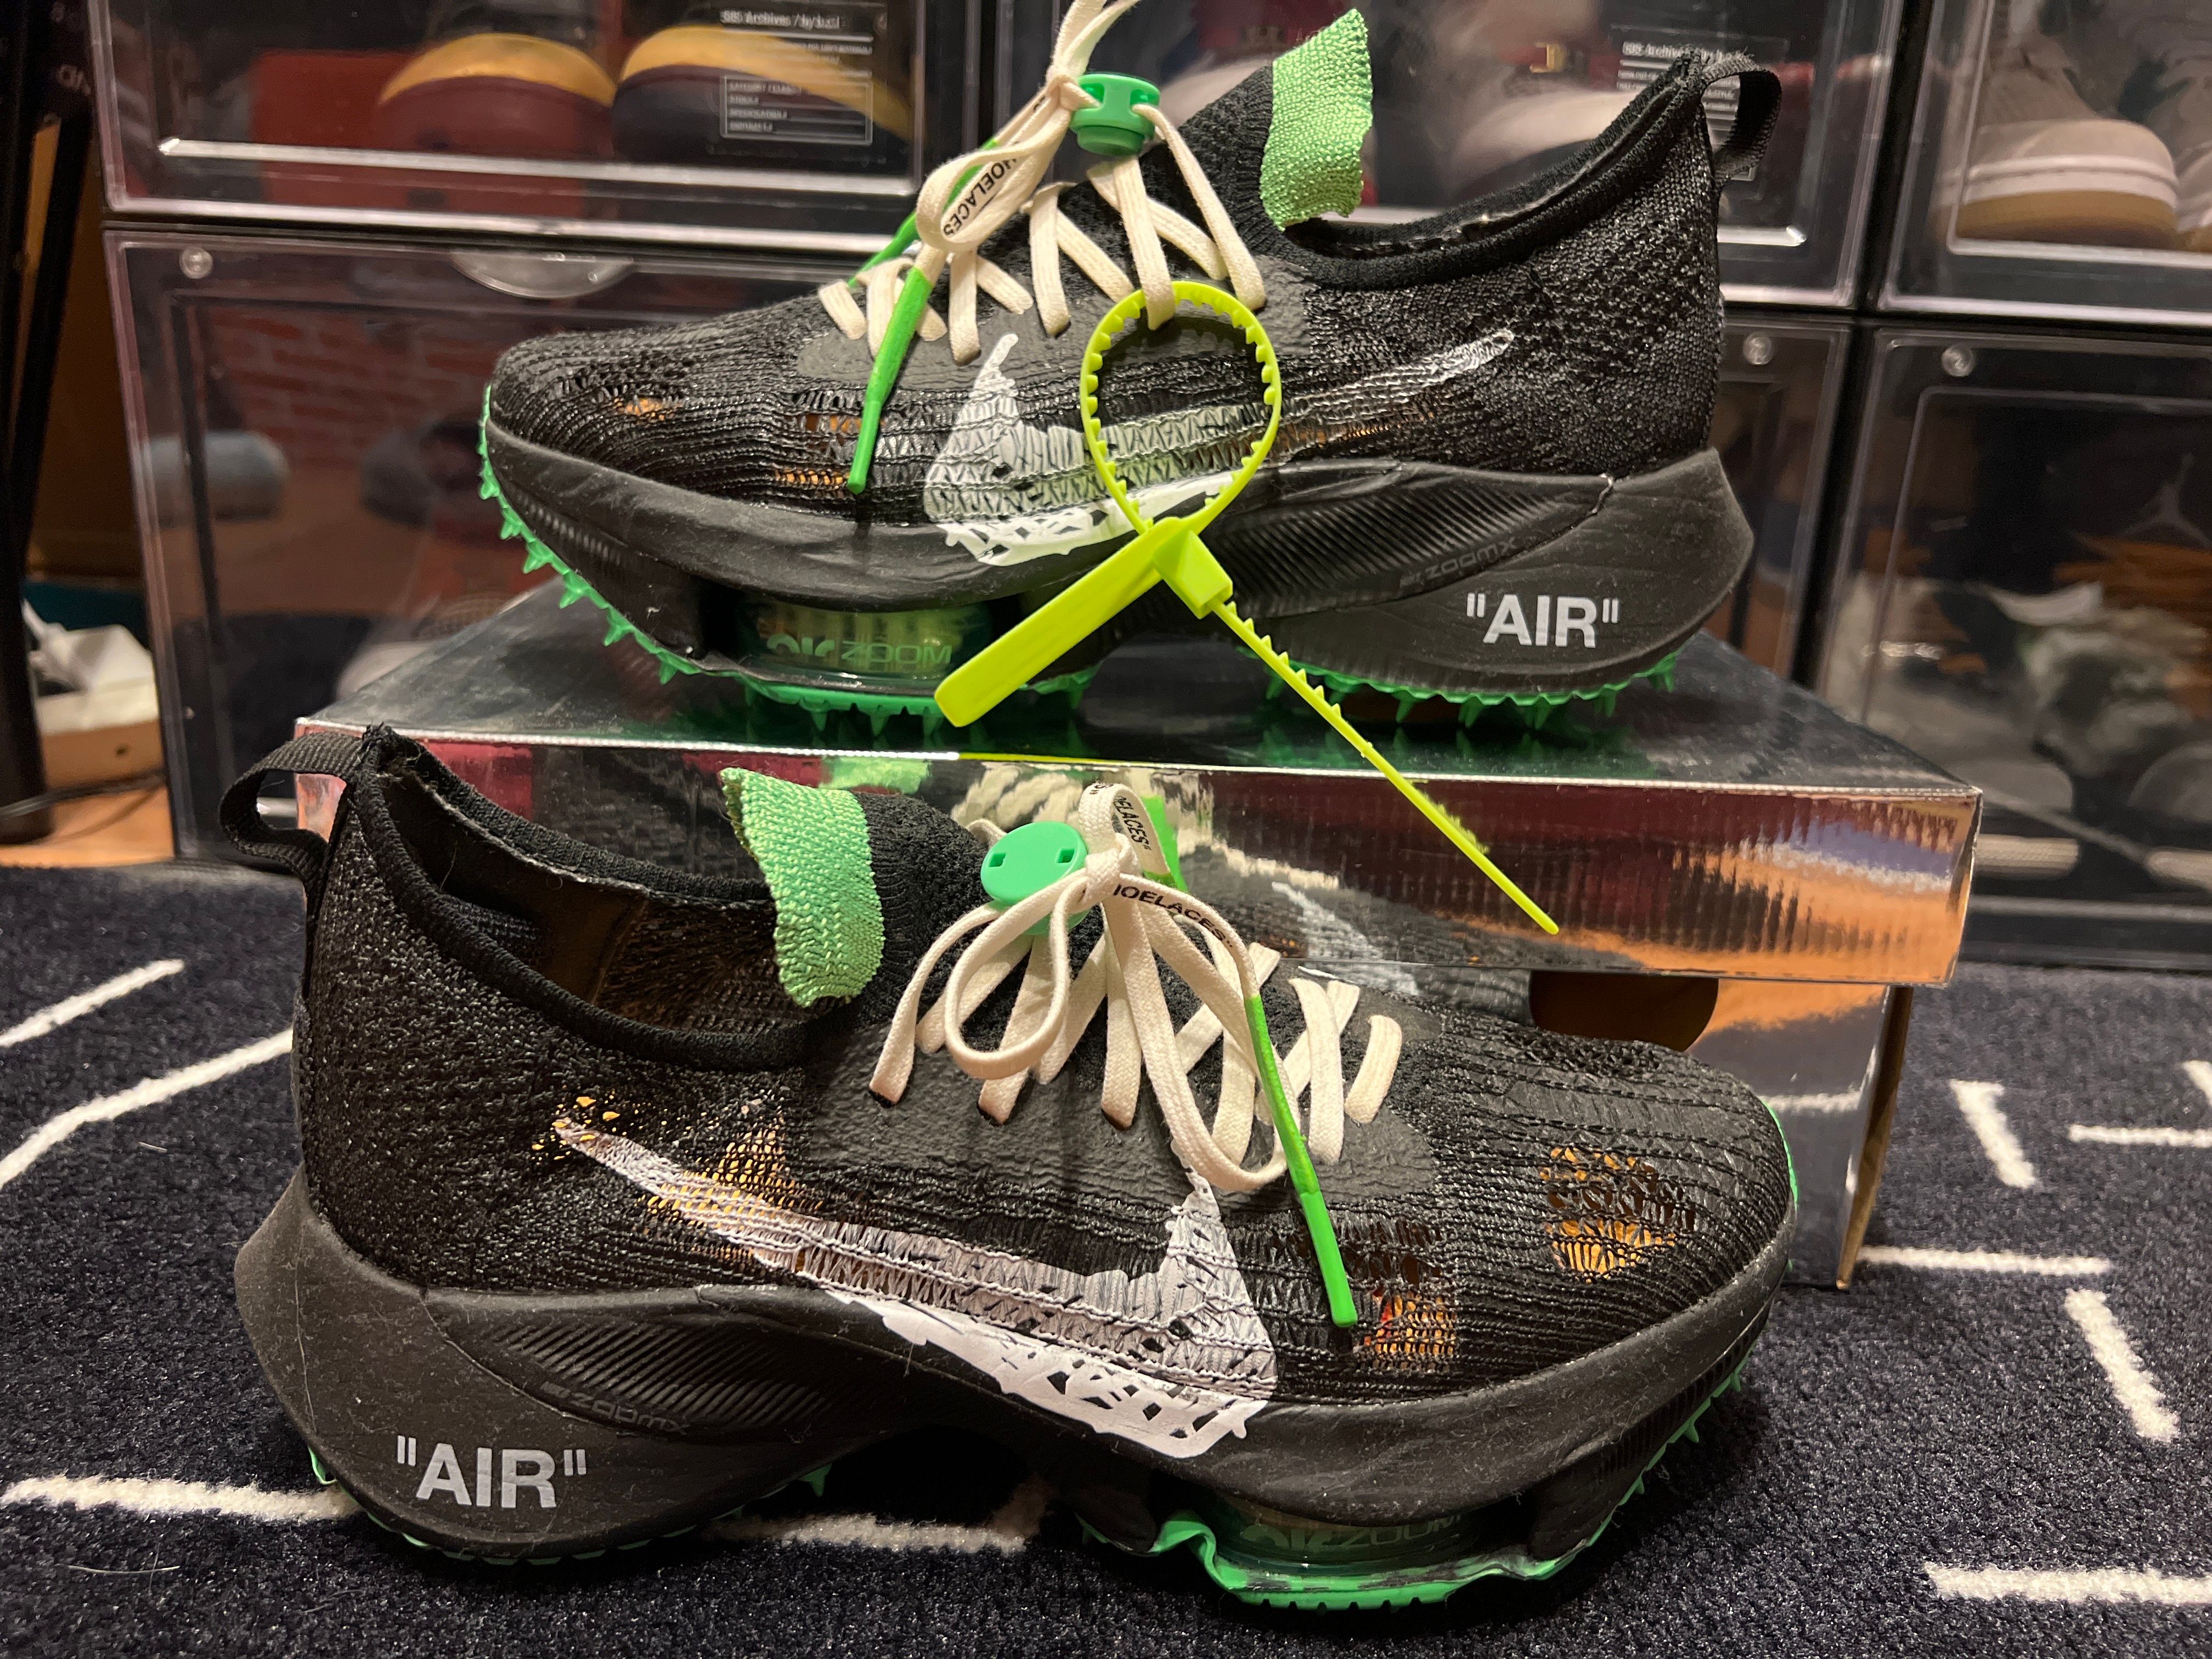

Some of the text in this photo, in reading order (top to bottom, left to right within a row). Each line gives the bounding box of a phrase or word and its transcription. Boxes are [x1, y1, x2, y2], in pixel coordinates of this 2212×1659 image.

[1466, 592, 1620, 648] "AIR"
[841, 640, 952, 664] ZOOM
[396, 1434, 587, 1509] "AIR"
